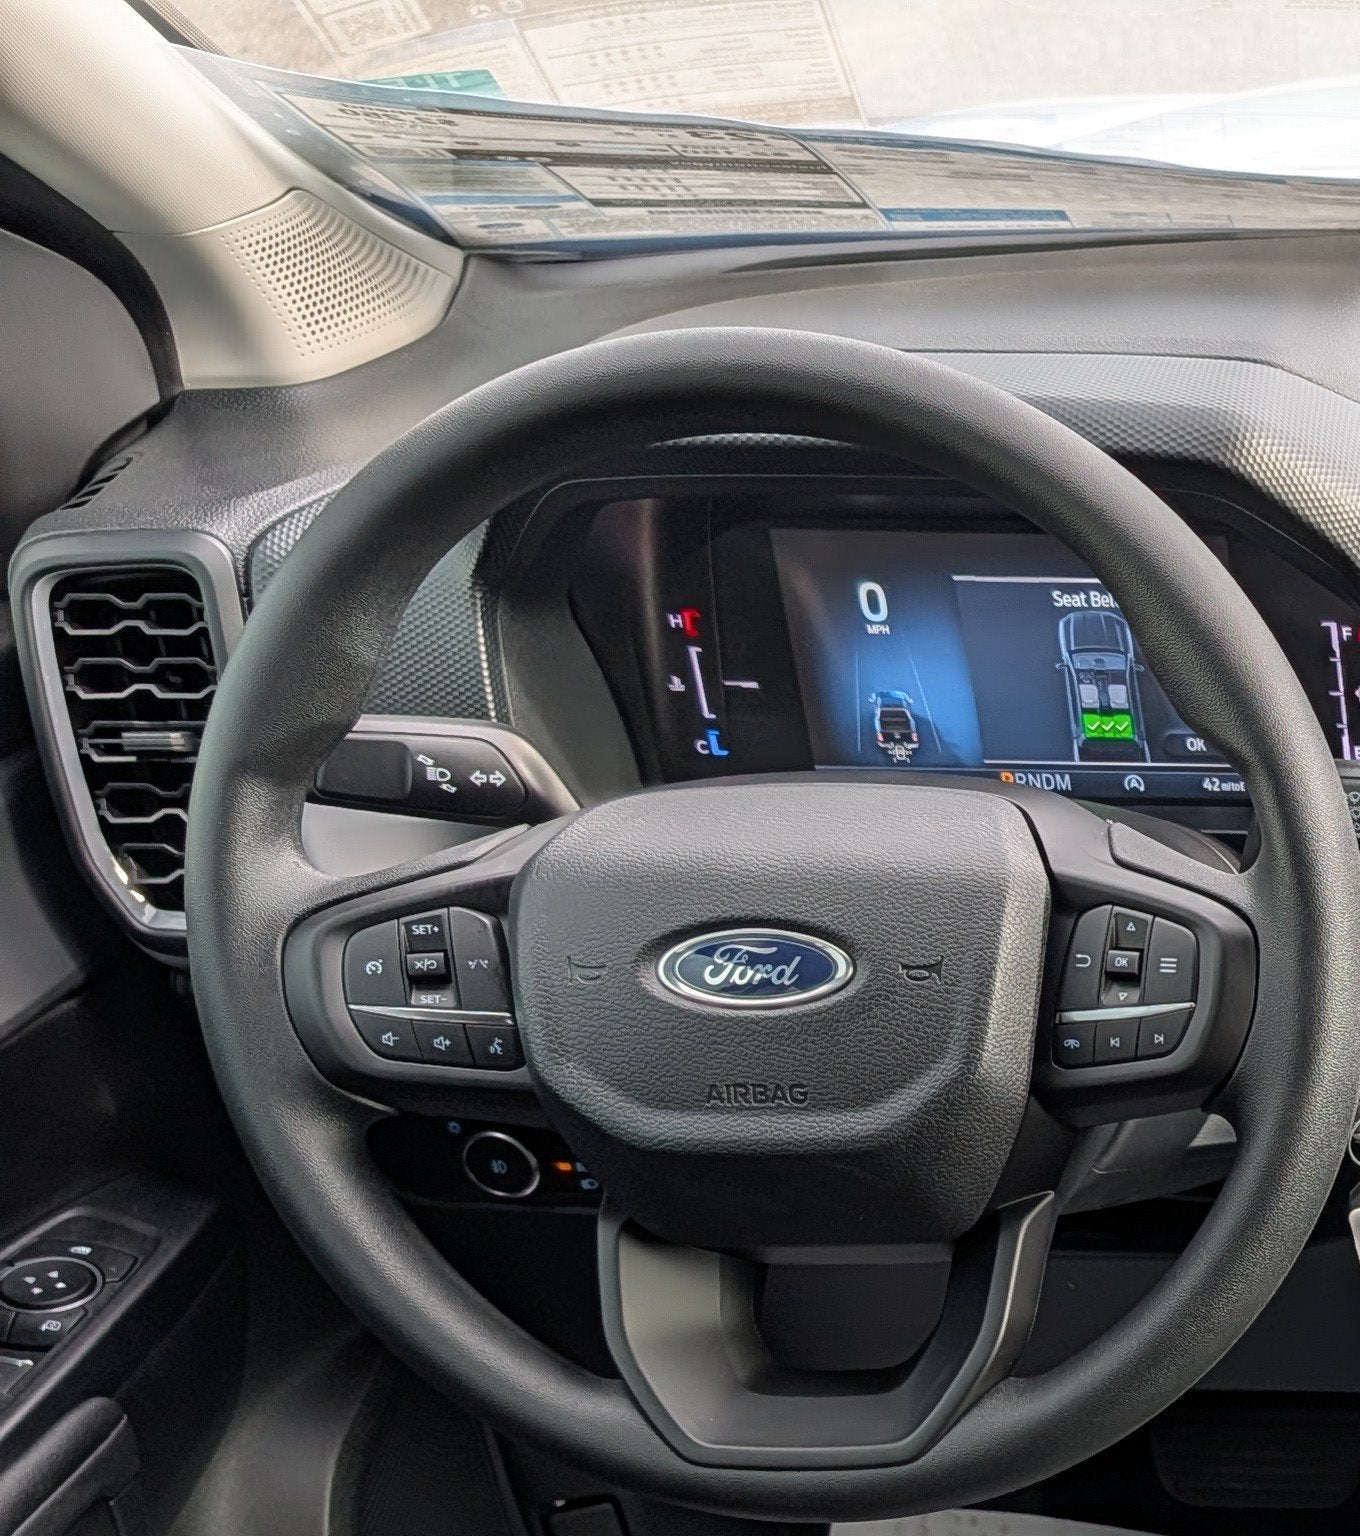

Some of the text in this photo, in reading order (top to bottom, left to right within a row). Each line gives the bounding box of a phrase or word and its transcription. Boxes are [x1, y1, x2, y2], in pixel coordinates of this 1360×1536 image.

[858, 581, 889, 623] 0
[1052, 590, 1119, 608] Seat Bel
[667, 612, 684, 629] H
[865, 624, 890, 635] MPH
[1340, 626, 1353, 642] F
[1185, 737, 1207, 752] OK
[1202, 777, 1220, 791] 42
[411, 924, 439, 935] SET+
[703, 944, 801, 986] Ford
[1114, 957, 1129, 967] OK
[705, 1083, 810, 1107] AIRBAG
